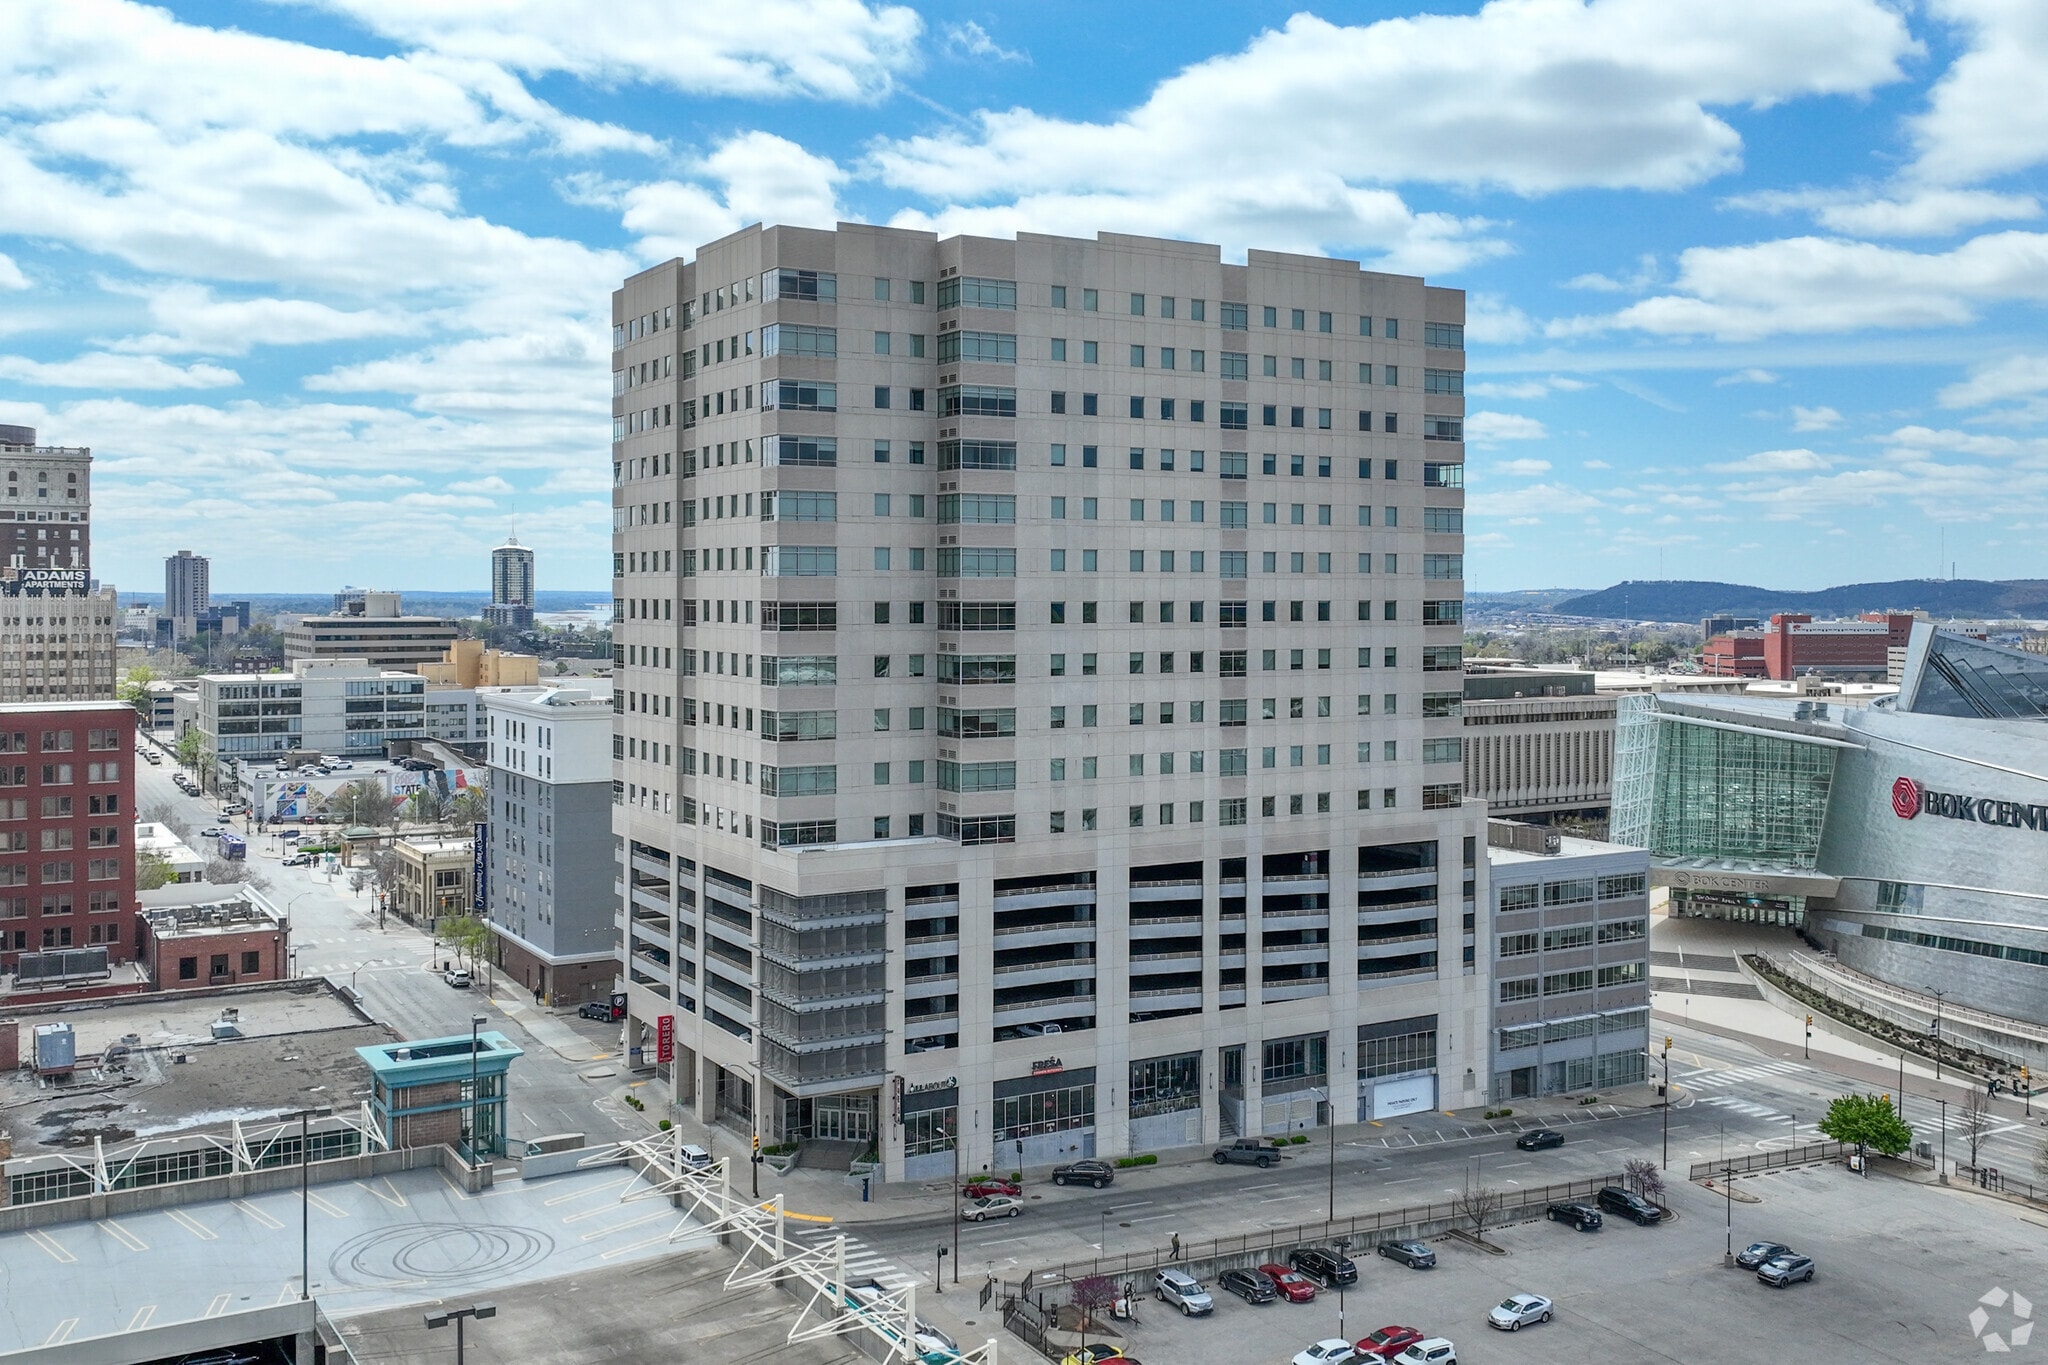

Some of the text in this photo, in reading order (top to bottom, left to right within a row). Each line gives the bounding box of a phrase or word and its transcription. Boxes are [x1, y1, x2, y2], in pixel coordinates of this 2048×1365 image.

[24, 571, 86, 580] ADAMS
[24, 580, 84, 588] APARTMENTS
[1924, 790, 1977, 823] BOK
[475, 824, 484, 845] Suites
[475, 850, 484, 869] Inn
[475, 869, 485, 907] Hampton
[1692, 875, 1770, 890] BOK CENTER
[662, 1017, 671, 1057] TORERO
